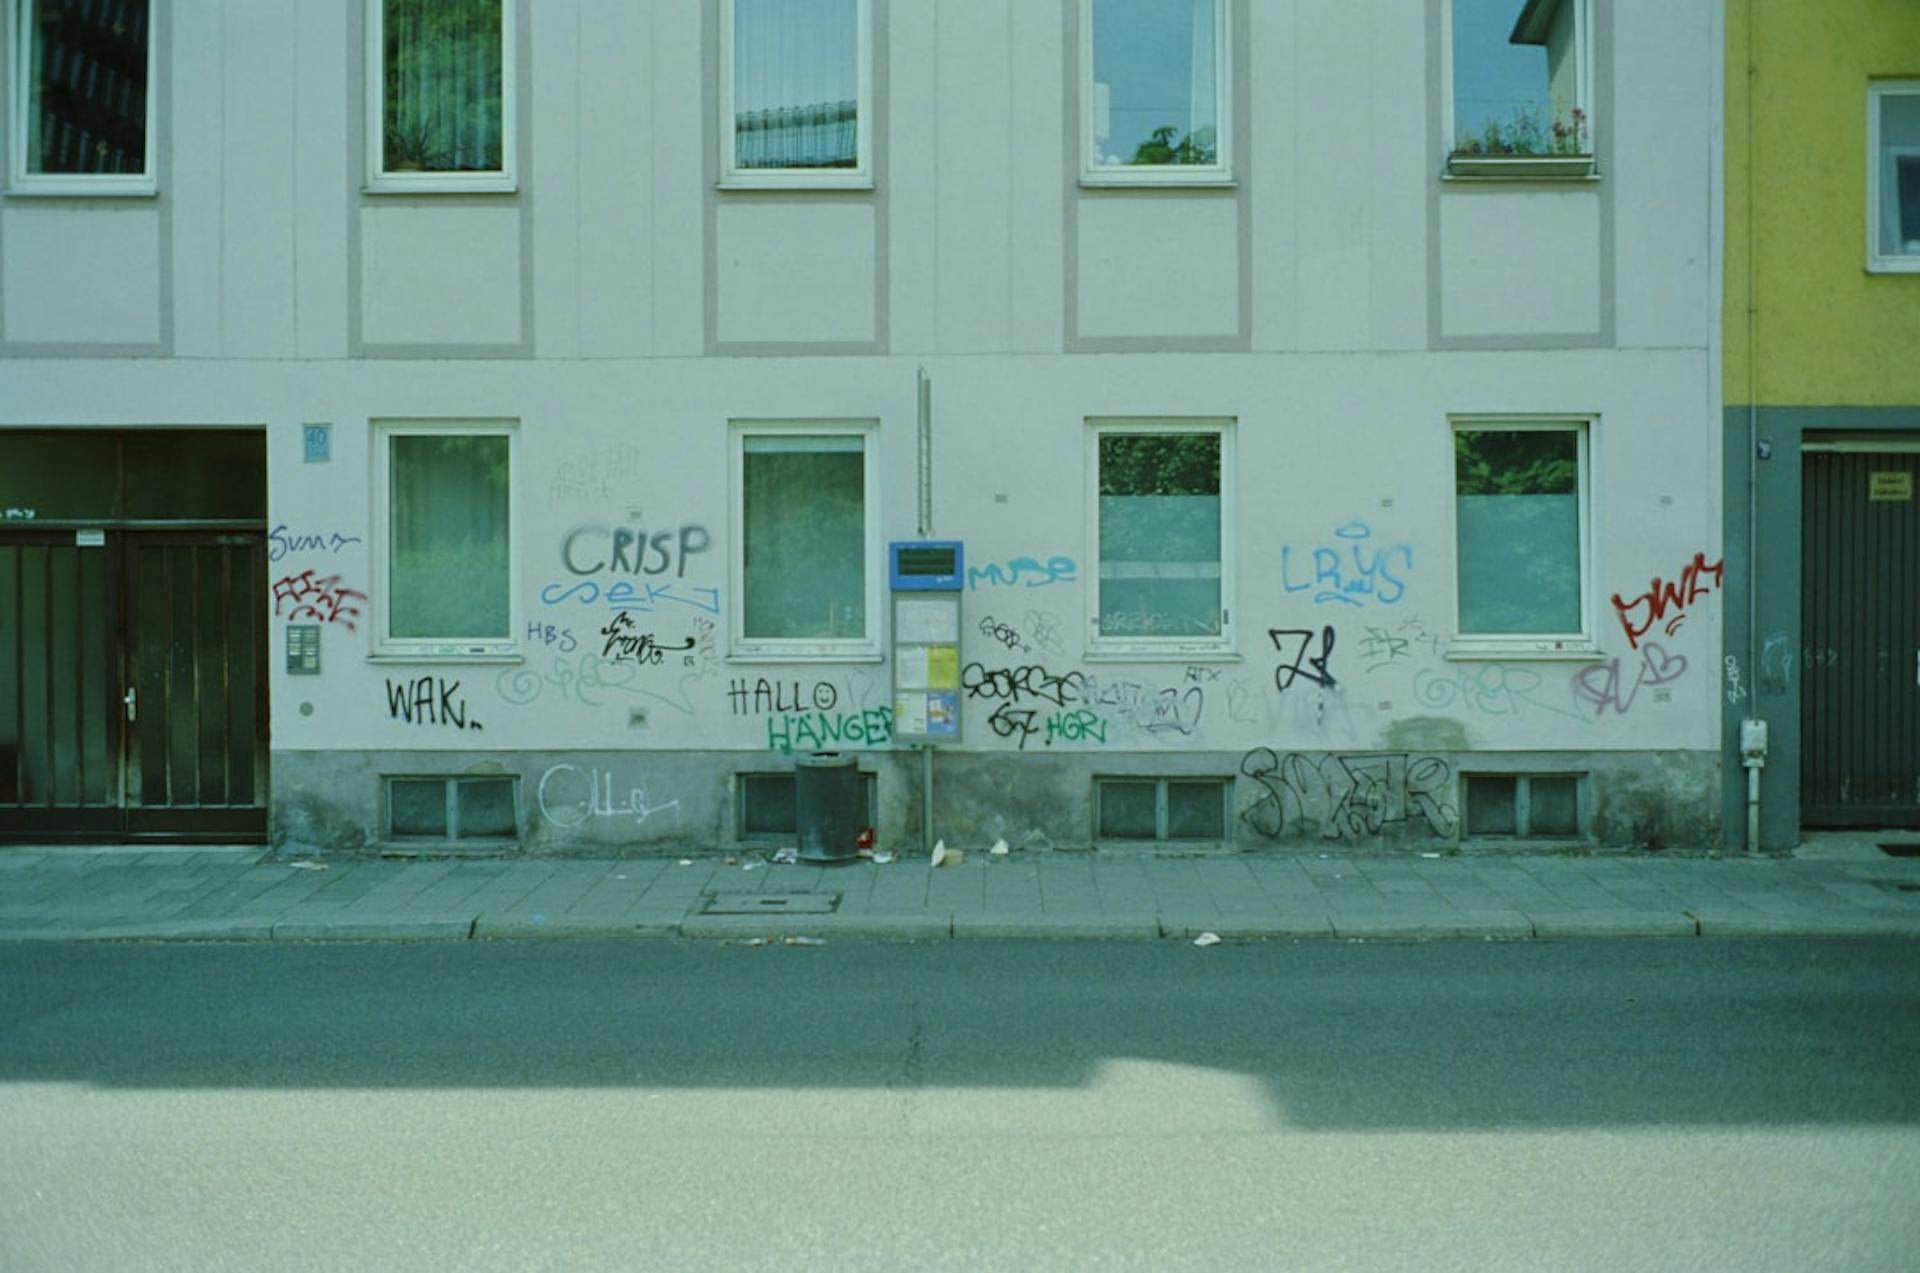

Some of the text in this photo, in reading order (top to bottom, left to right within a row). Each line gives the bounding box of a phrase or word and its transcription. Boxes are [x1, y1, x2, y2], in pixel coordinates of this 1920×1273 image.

[306, 428, 327, 445] 40
[562, 524, 710, 578] CRISP
[527, 621, 577, 652] HBS
[727, 676, 838, 716] HALLO
